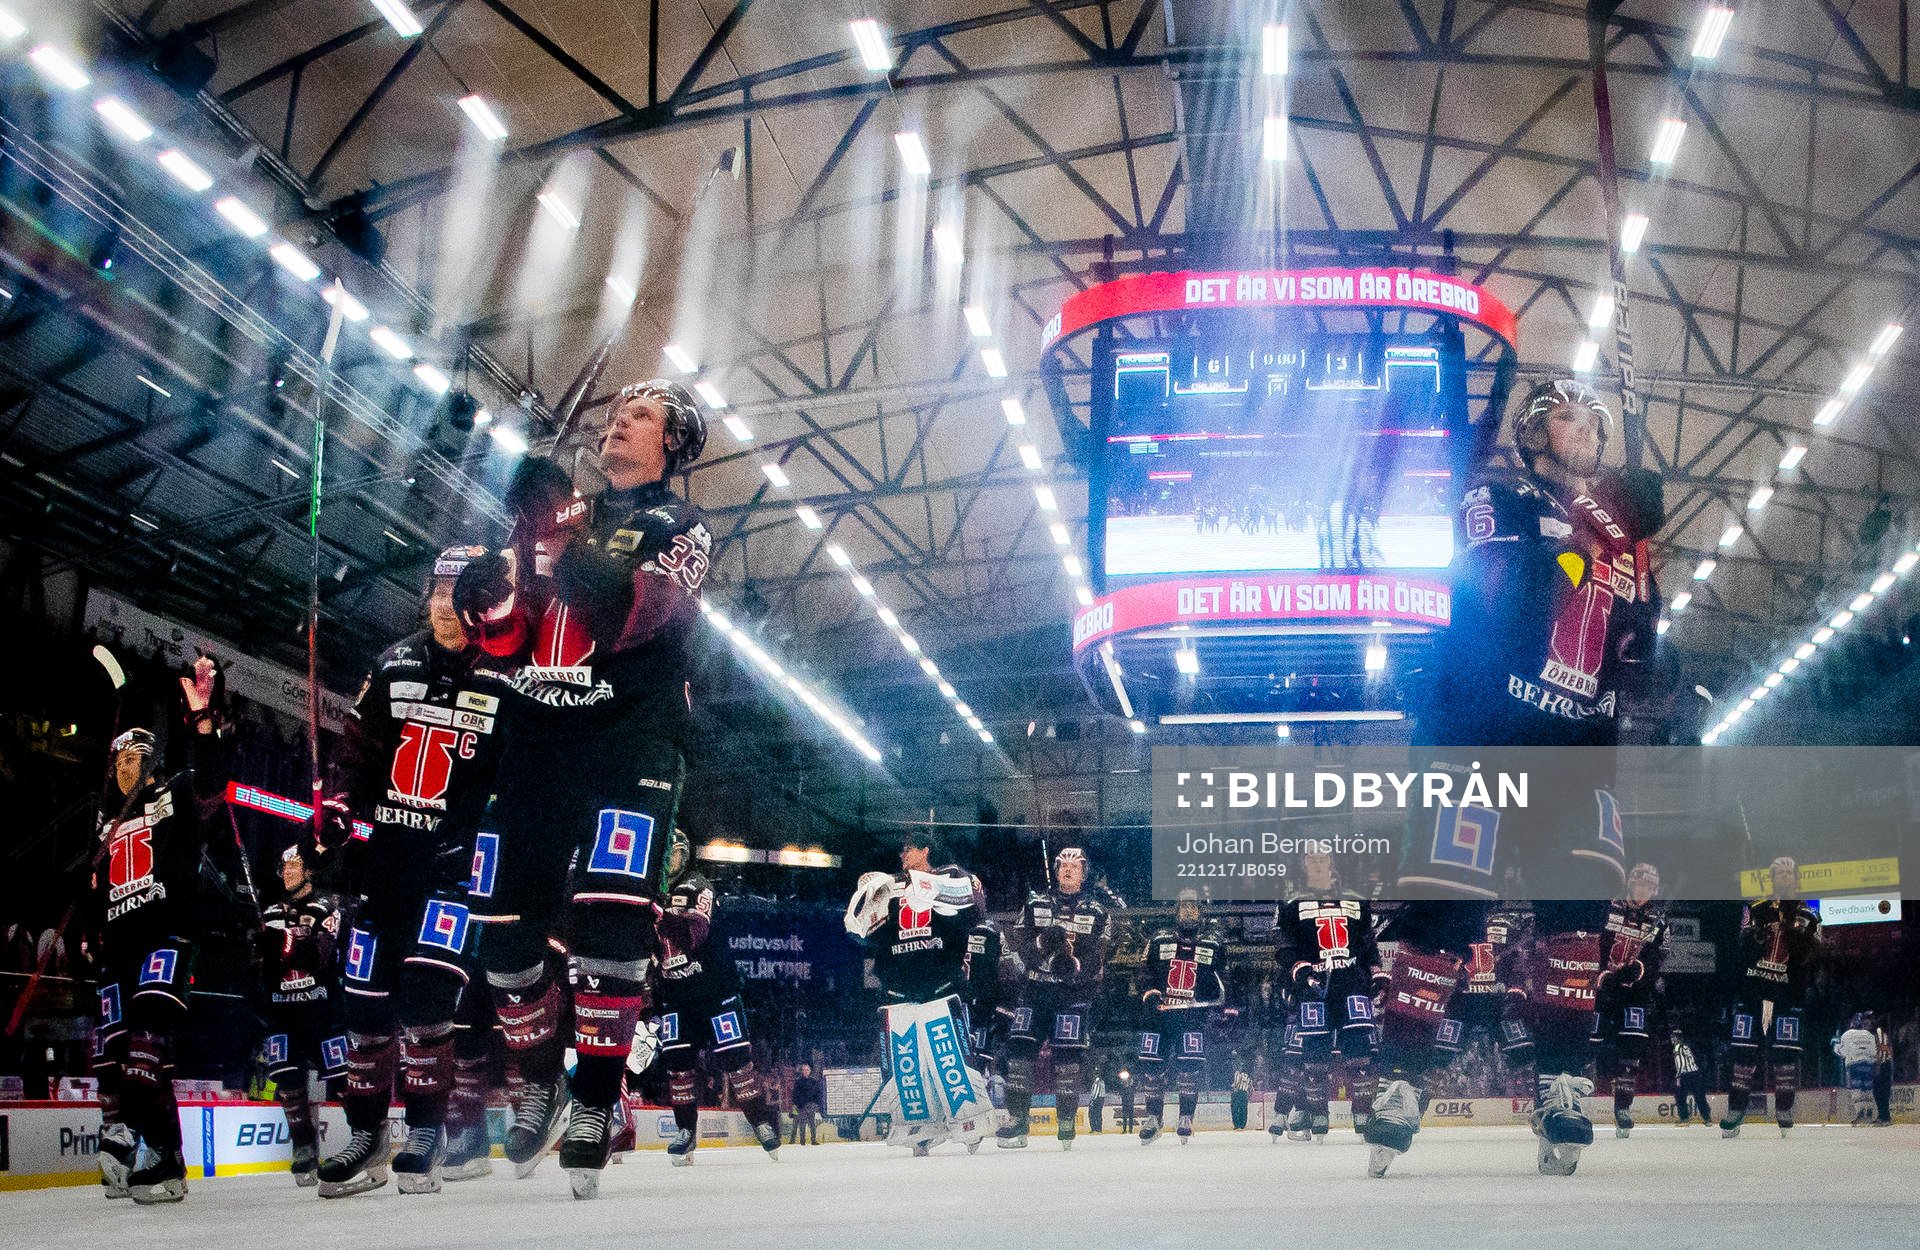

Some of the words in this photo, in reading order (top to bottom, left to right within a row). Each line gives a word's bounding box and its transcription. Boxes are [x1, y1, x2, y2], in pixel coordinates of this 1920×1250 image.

[1186, 279, 1231, 303] DET
[1236, 275, 1268, 301] ÄR
[1273, 277, 1296, 300] VI
[1301, 276, 1354, 300] SOM
[1360, 273, 1392, 299] ÄR
[1396, 273, 1480, 315] ÖREBRO
[1467, 504, 1496, 541] 6
[659, 534, 709, 589] 33
[1177, 587, 1224, 615] DET
[1230, 582, 1262, 612] ÄR
[1268, 584, 1291, 612] VI
[1296, 583, 1351, 611] SOM
[1357, 579, 1390, 611] ÄR
[530, 669, 586, 682] ÖREBRO
[461, 713, 486, 728] OBK
[458, 731, 478, 760] C
[1828, 905, 1876, 916] Swedbank
[1549, 958, 1584, 971] TRUCK
[1408, 966, 1440, 985] TRUCK
[1546, 984, 1595, 999] STILL
[1397, 991, 1446, 1013] STILL
[931, 1023, 968, 1100] HEROK
[127, 1067, 157, 1082] STILL
[897, 1038, 925, 1115] HEROK
[1435, 1102, 1473, 1115] OBK
